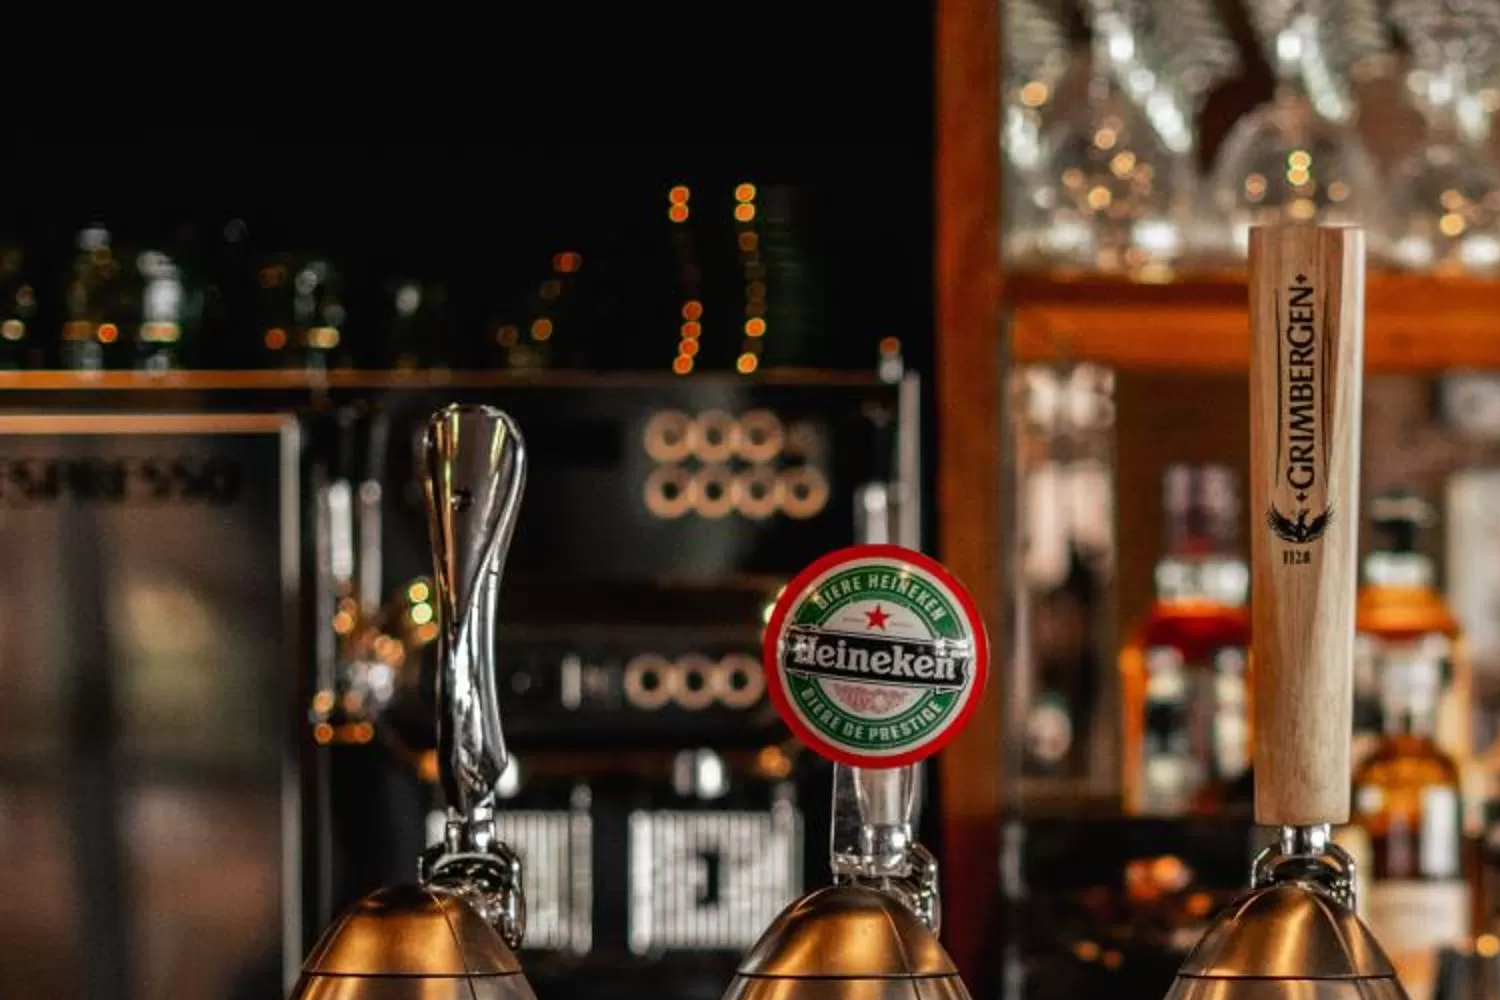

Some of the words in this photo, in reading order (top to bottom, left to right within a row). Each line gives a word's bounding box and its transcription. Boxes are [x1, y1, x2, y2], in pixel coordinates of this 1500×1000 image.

[1287, 288, 1316, 490] GRIMBERGEN
[868, 573, 947, 622] HEINEKEN
[794, 635, 956, 680] Heineken
[842, 721, 865, 741] DE
[868, 702, 943, 741] PRESTIGE
